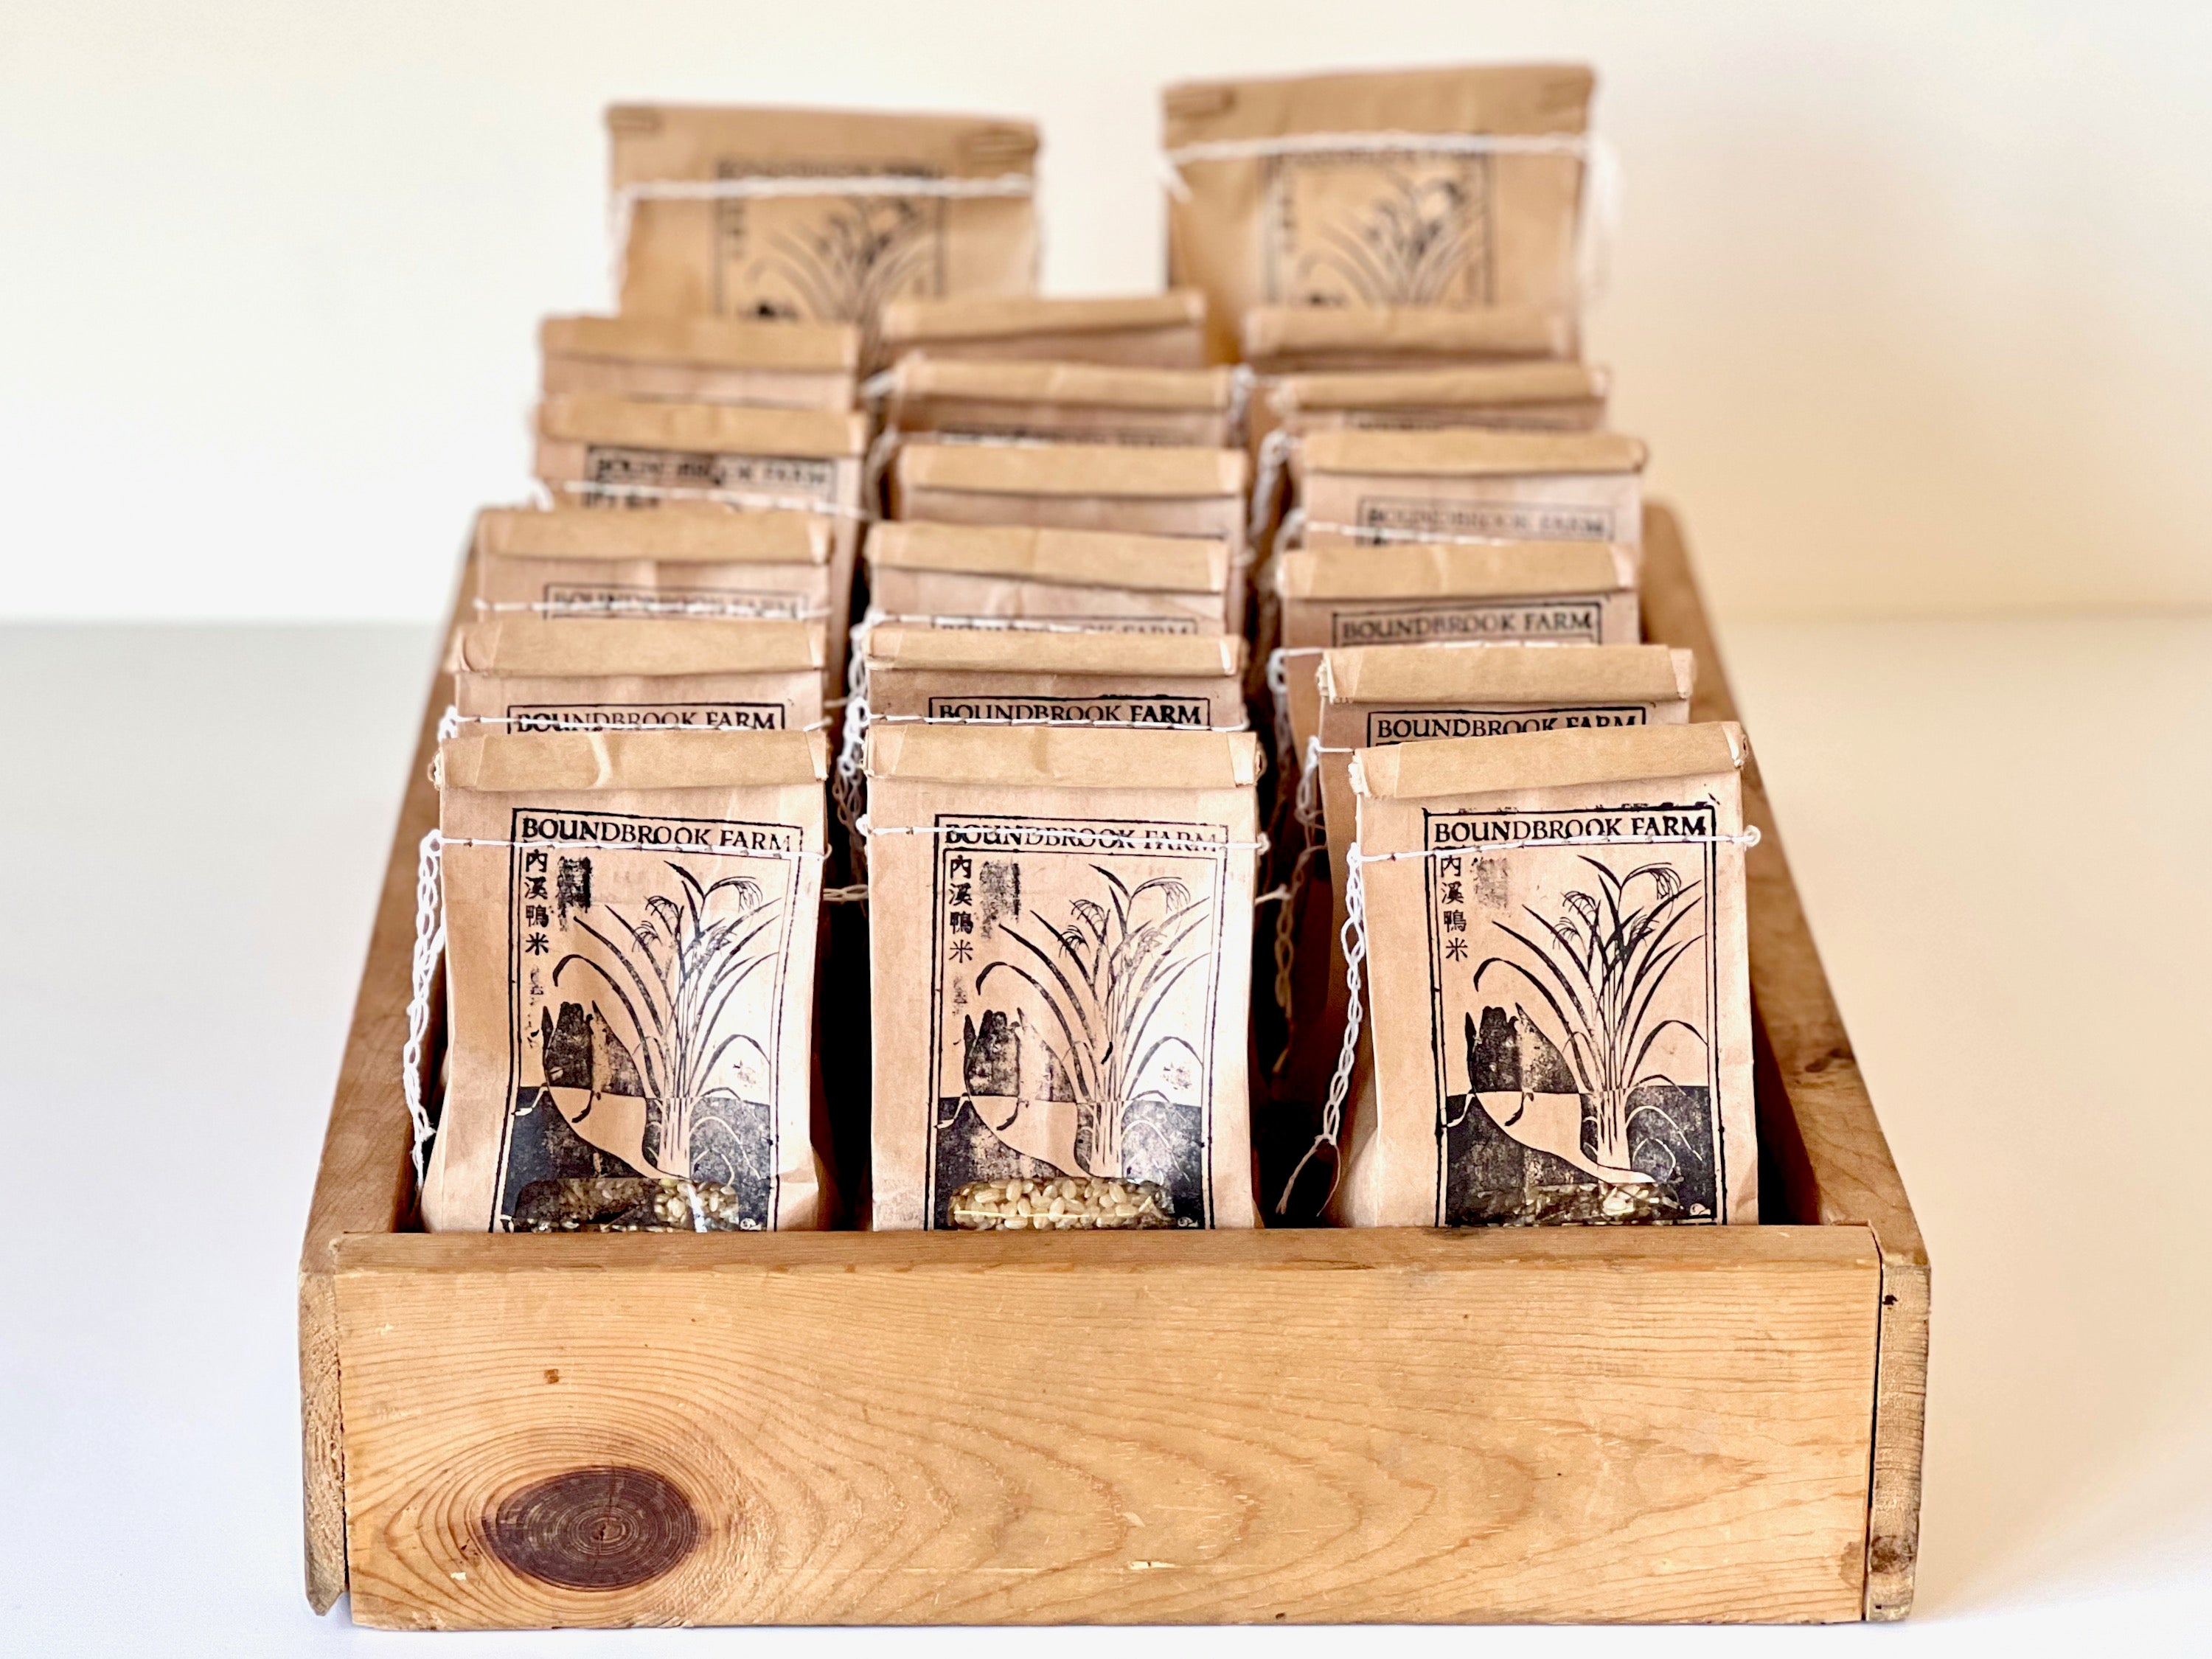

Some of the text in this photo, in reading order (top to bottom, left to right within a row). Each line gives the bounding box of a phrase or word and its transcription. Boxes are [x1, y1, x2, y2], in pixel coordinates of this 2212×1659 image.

[1343, 611, 1591, 639] BOUNDBROOK FARM
[939, 704, 1200, 725] BOUNDBROOK FARM
[522, 818, 790, 852] BOUNDBROOK FARM
[945, 823, 1135, 849] BOUNDBROOK
[1434, 815, 1706, 842] BOUNDBROOK FARM
